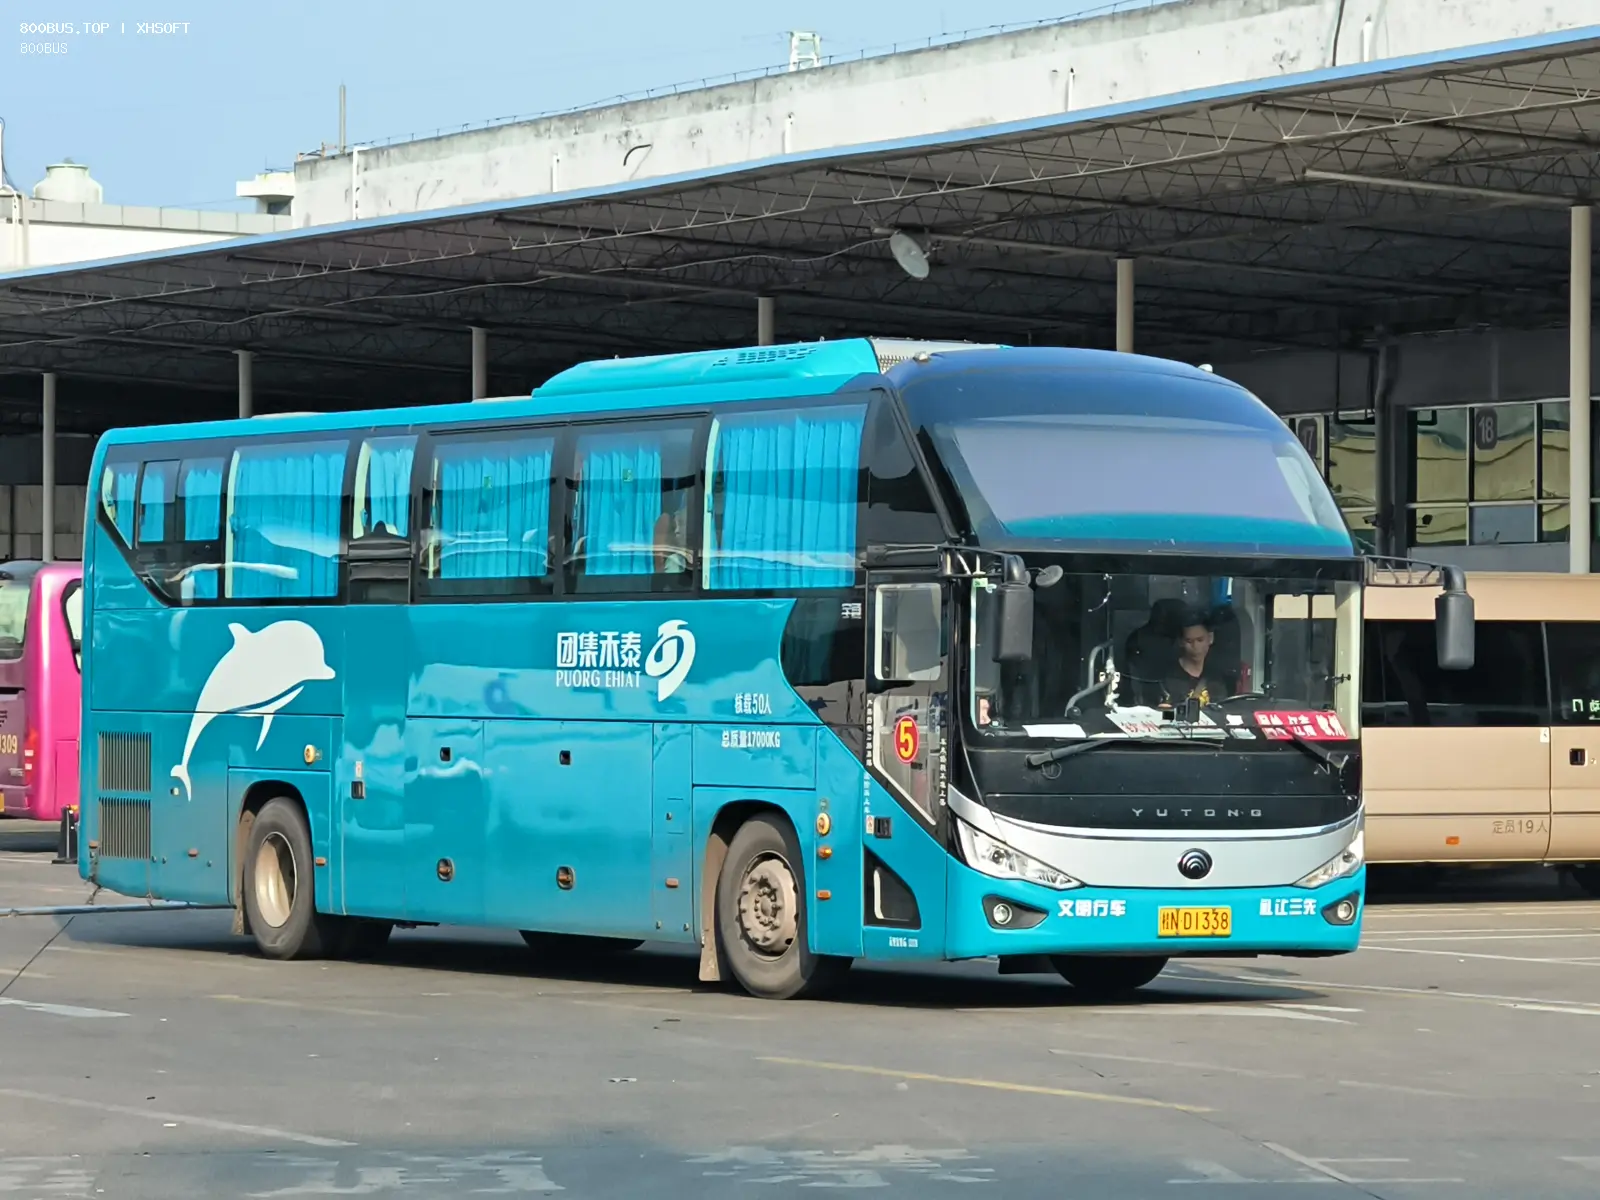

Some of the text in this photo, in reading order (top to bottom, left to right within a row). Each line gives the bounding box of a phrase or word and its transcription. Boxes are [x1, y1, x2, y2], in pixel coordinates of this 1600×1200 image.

[1479, 416, 1494, 443] 18
[556, 669, 642, 688] PUORG EHIAT
[0, 734, 18, 754] 309
[900, 720, 914, 758] 5
[1132, 807, 1262, 818] YUTONG
[1492, 820, 1549, 835] 定员19人
[1057, 899, 1127, 918] 文明行车
